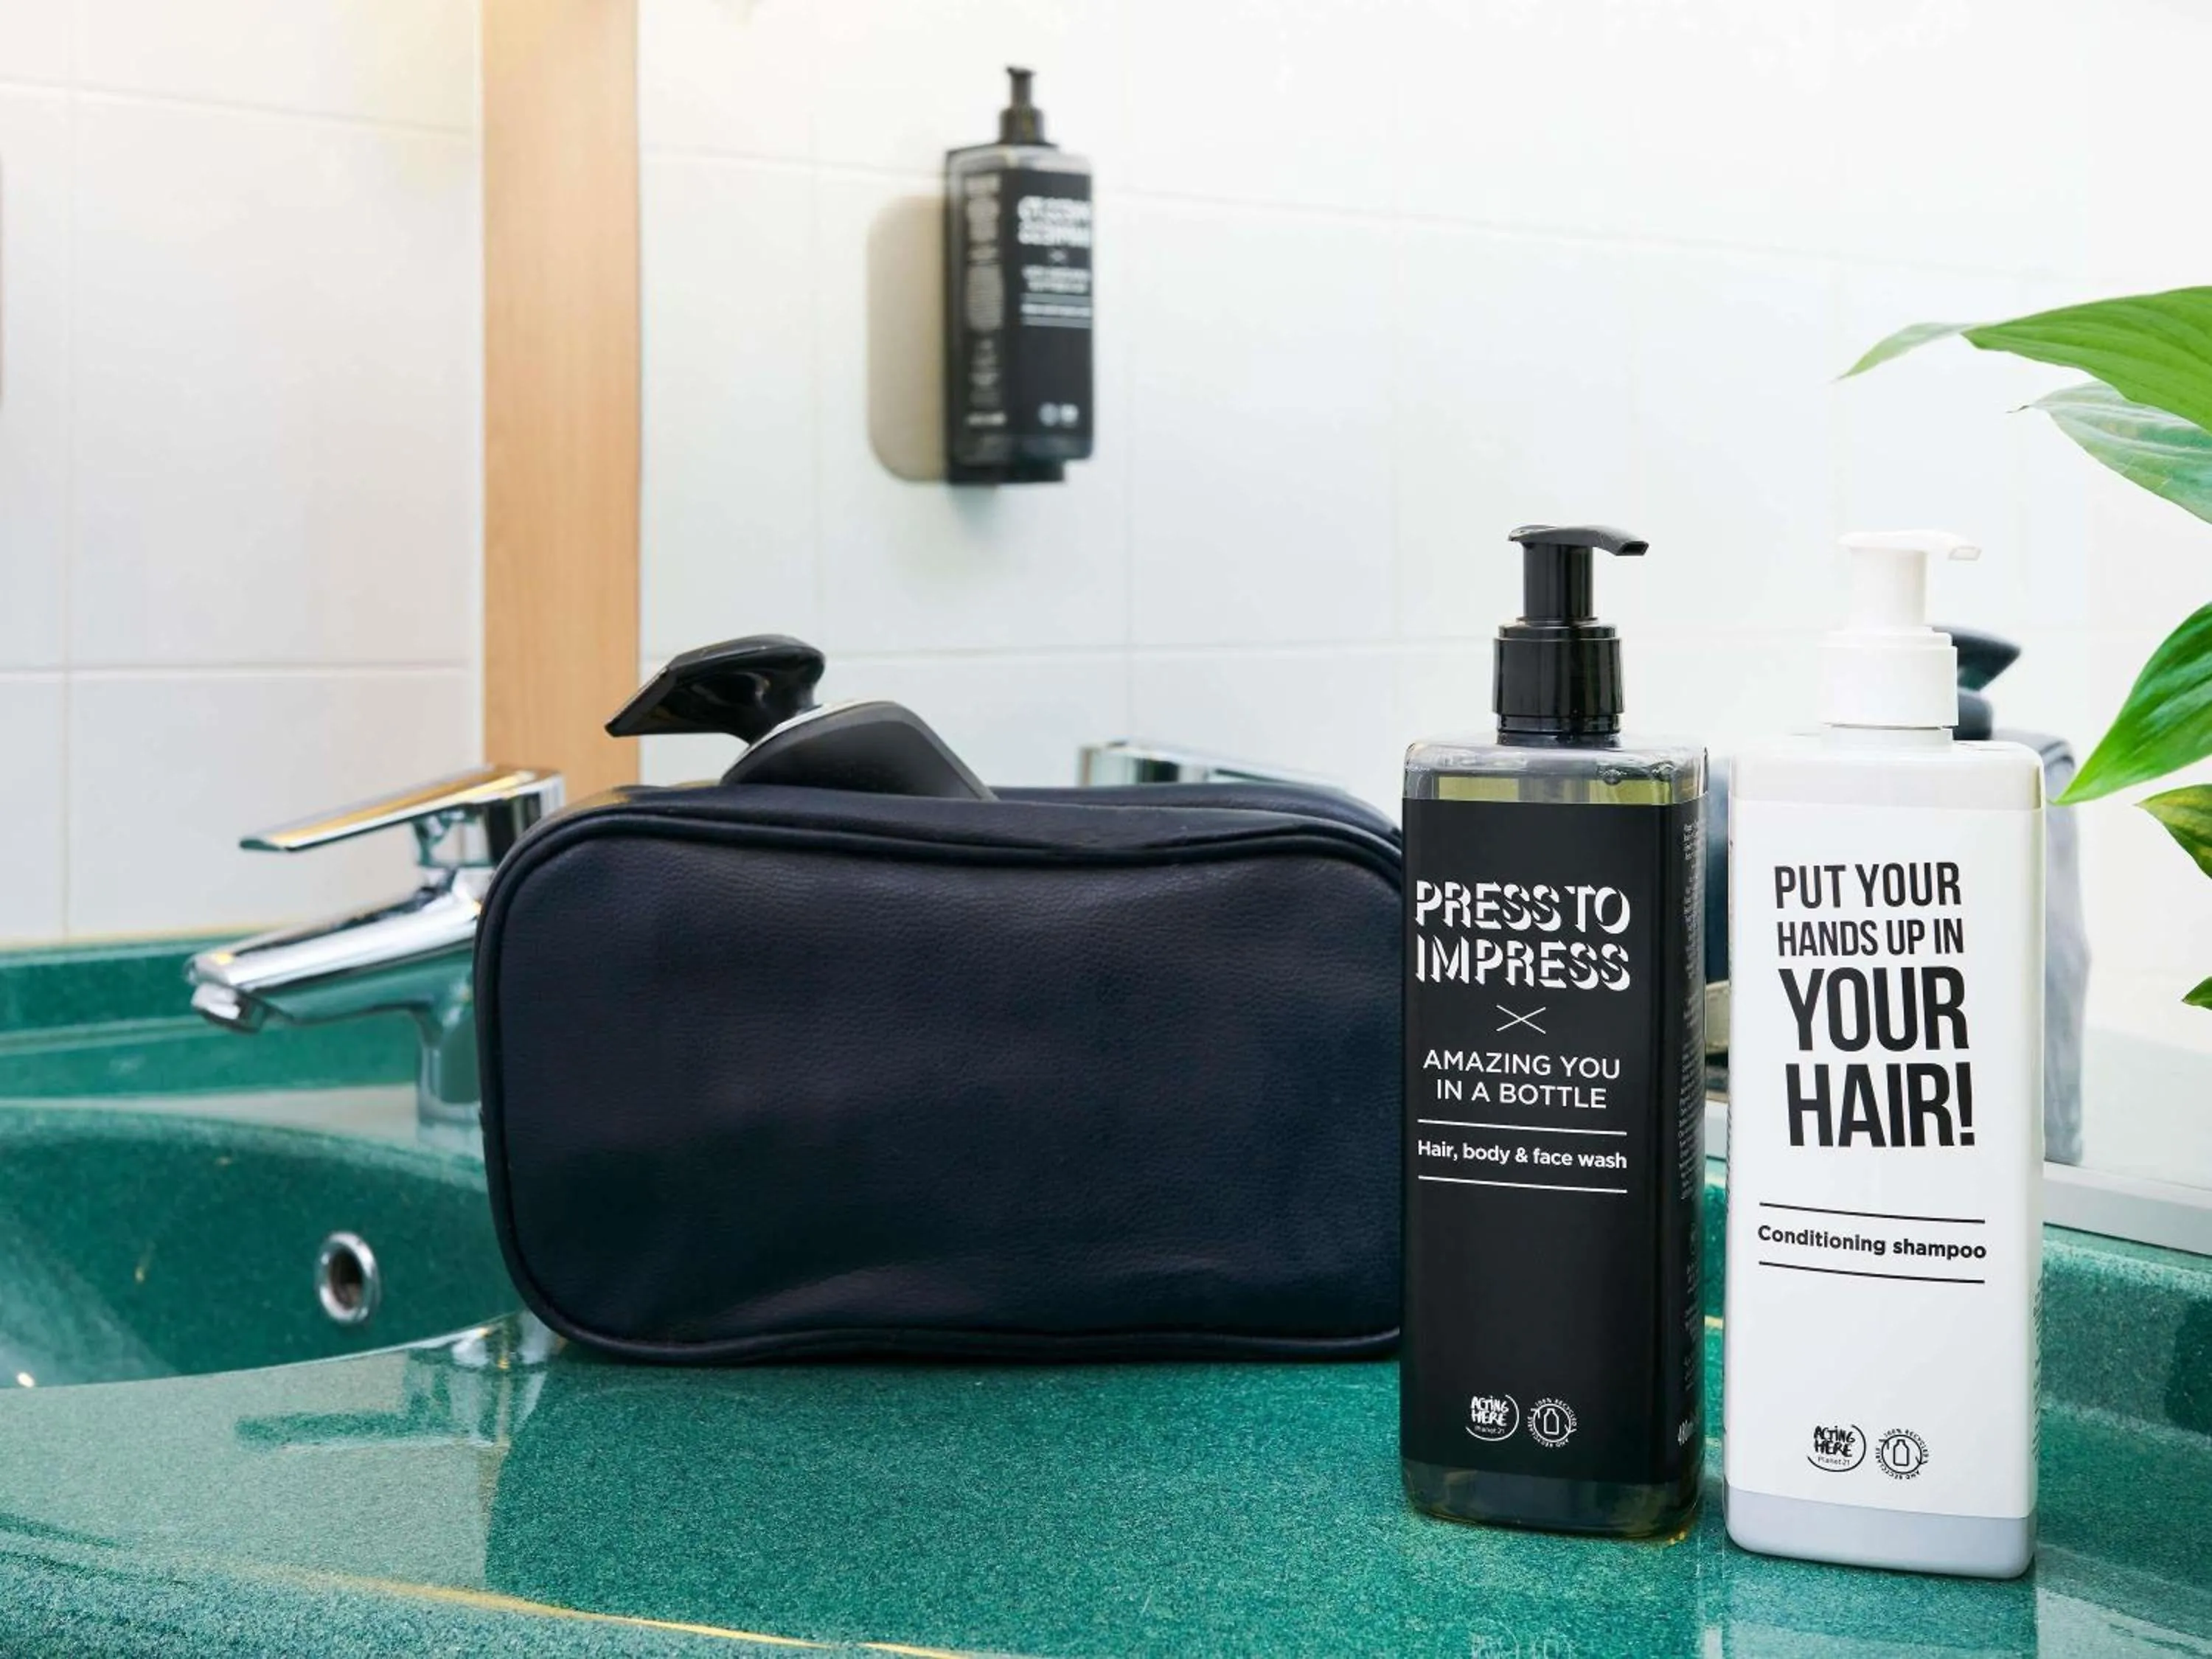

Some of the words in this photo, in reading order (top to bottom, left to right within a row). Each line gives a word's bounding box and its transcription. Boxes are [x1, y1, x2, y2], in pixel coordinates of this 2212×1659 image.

[1775, 865, 1846, 908] PUT
[1855, 862, 1962, 907] YOUR
[1416, 880, 1562, 931] PRESS
[1564, 885, 1630, 934] TO
[1777, 920, 1879, 956] HANDS
[1886, 919, 1924, 956] UP
[1934, 918, 1964, 955] IN
[1416, 935, 1630, 991] IMPRESS
[1778, 966, 1969, 1051] YOUR
[1423, 1049, 1551, 1075] AMAZING
[1559, 1056, 1620, 1079] YOU
[1437, 1079, 1462, 1100] IN
[1471, 1082, 1491, 1102] A
[1499, 1083, 1607, 1108] BOTTLE
[1786, 1062, 1975, 1147] HAIR!
[1418, 1140, 1458, 1161] Hair,
[1463, 1143, 1511, 1164] body
[1514, 1147, 1528, 1163] &
[1532, 1148, 1573, 1166] face
[1578, 1152, 1627, 1169] wash
[1758, 1225, 1886, 1256] Conditioning
[1893, 1238, 1987, 1260] shampoo
[1471, 1410, 1507, 1427] HERE
[1815, 1439, 1852, 1457] HERE
